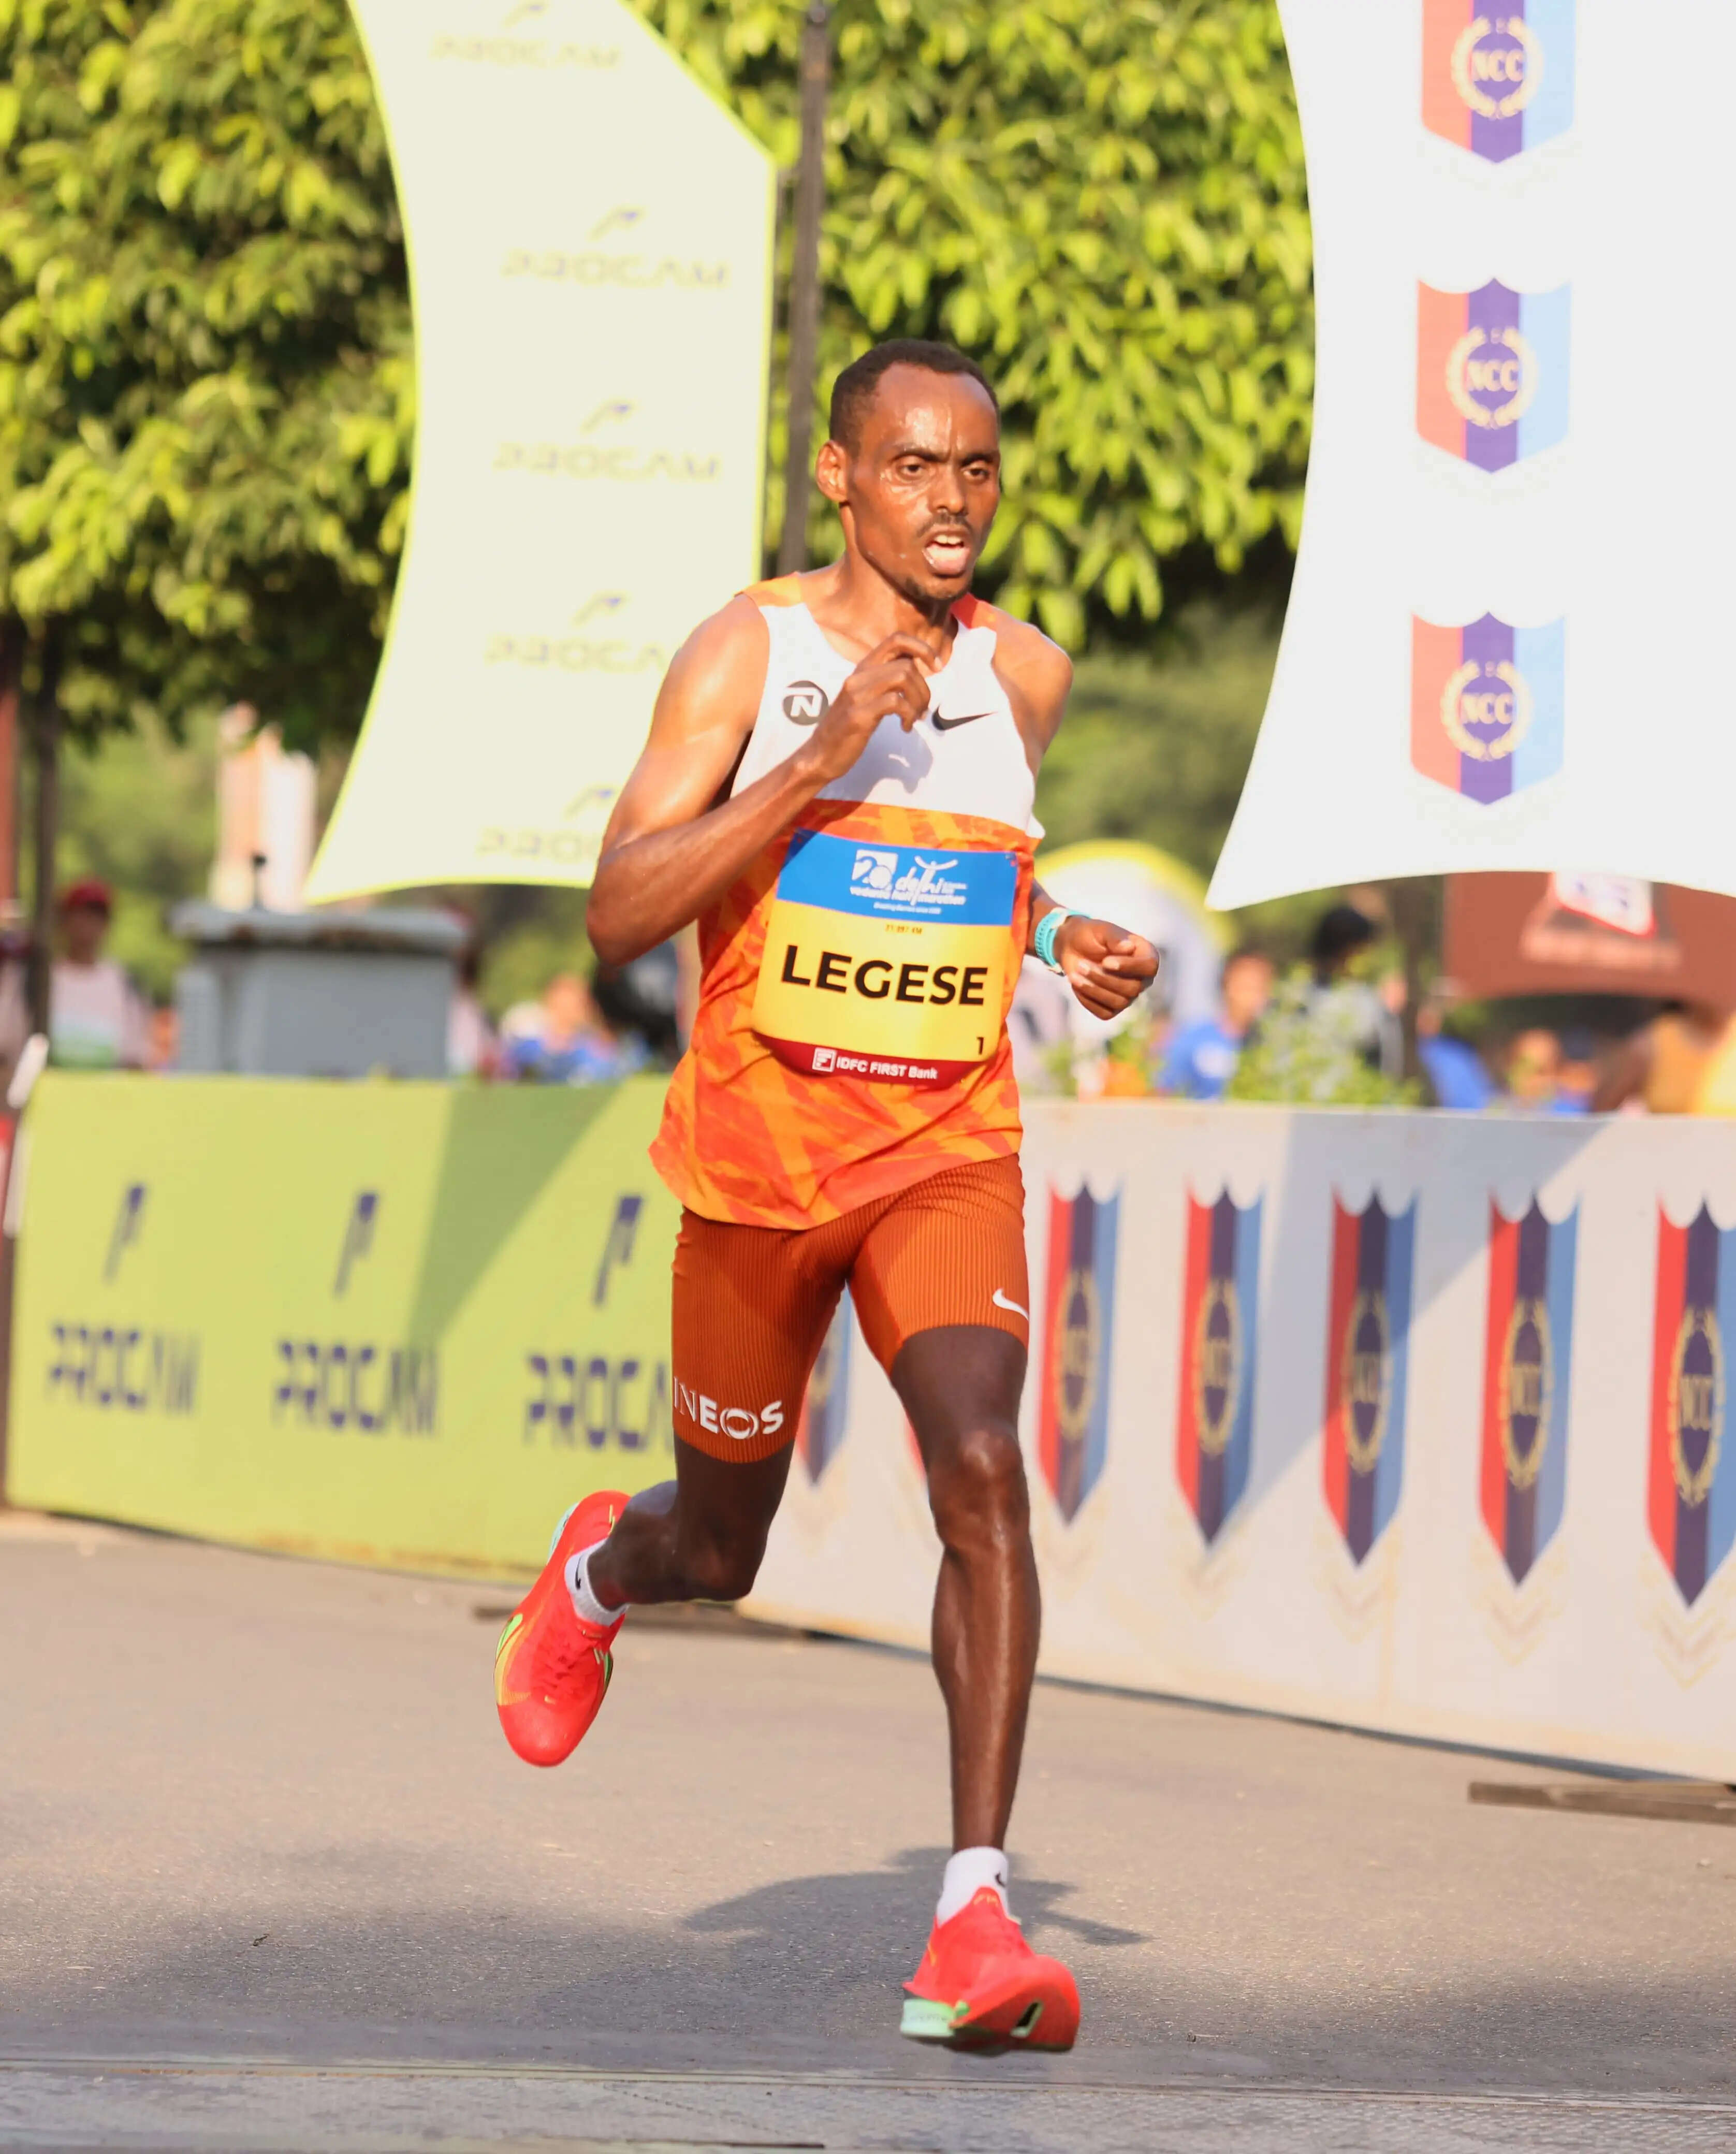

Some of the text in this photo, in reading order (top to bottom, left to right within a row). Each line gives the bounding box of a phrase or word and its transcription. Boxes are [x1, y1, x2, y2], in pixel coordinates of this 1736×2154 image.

[1471, 48, 1524, 82] NCC
[1467, 358, 1519, 392] NCC
[484, 633, 669, 674] PROCA
[1461, 692, 1515, 724] NCC
[781, 944, 988, 1005] LEGESE
[976, 1036, 985, 1055] 1
[836, 1055, 938, 1080] IDFC FIRST Bank
[523, 1352, 672, 1454] PROCA
[673, 1376, 784, 1440] INEOS
